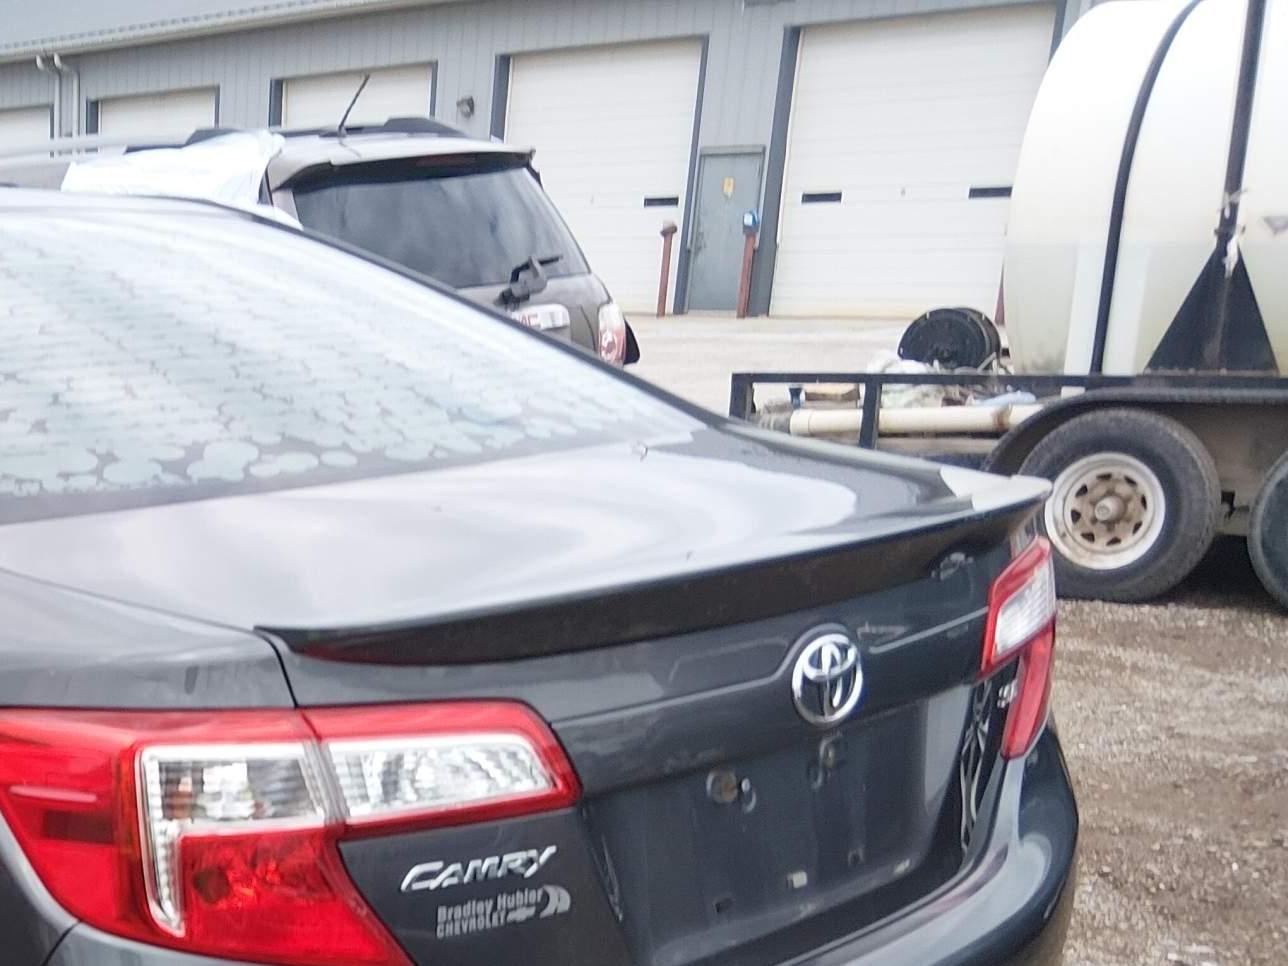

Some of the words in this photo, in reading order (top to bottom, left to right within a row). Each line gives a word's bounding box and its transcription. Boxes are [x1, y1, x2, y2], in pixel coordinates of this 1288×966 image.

[400, 845, 557, 892] CAMRY
[437, 898, 493, 922] Bradley
[497, 886, 543, 906] Hubler
[437, 910, 506, 939] CHEVROLET
